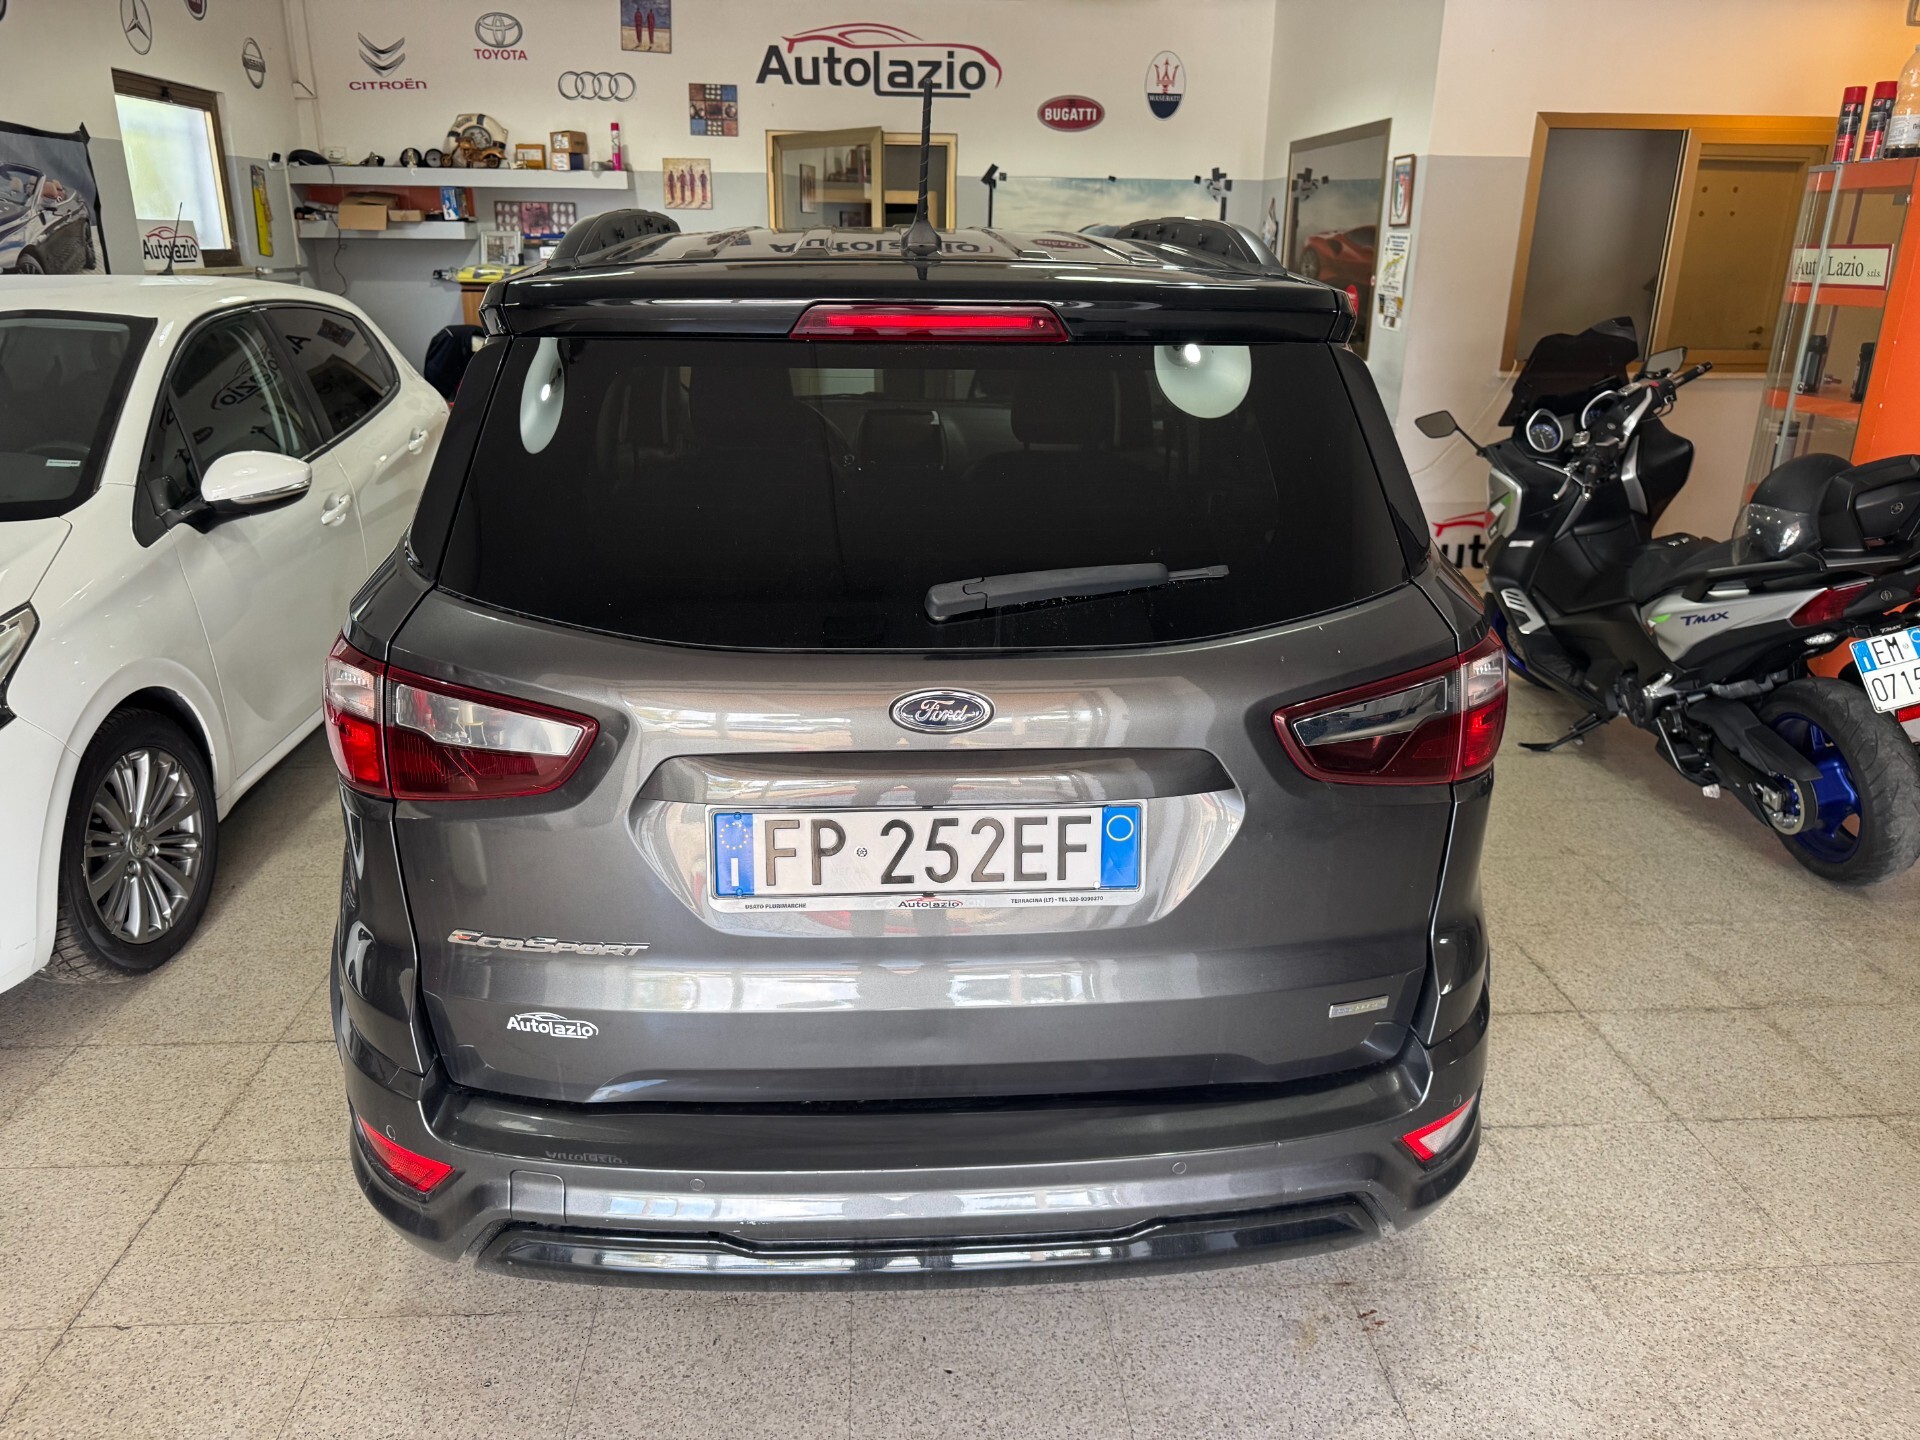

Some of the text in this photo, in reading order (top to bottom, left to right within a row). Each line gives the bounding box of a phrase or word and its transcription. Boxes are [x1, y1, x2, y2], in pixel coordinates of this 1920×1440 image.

[474, 49, 527, 60] TOYOTA
[756, 45, 986, 98] AutoLazio
[1045, 108, 1097, 121] BUGATTI
[1827, 256, 1864, 277] Lazio
[1680, 611, 1729, 626] TMAX
[1871, 636, 1905, 665] EM
[915, 699, 969, 722] Ford
[764, 819, 847, 886] FP
[879, 815, 1092, 884] 252EF
[898, 900, 960, 909] AutoLazio
[507, 1016, 594, 1039] AutoLazio
